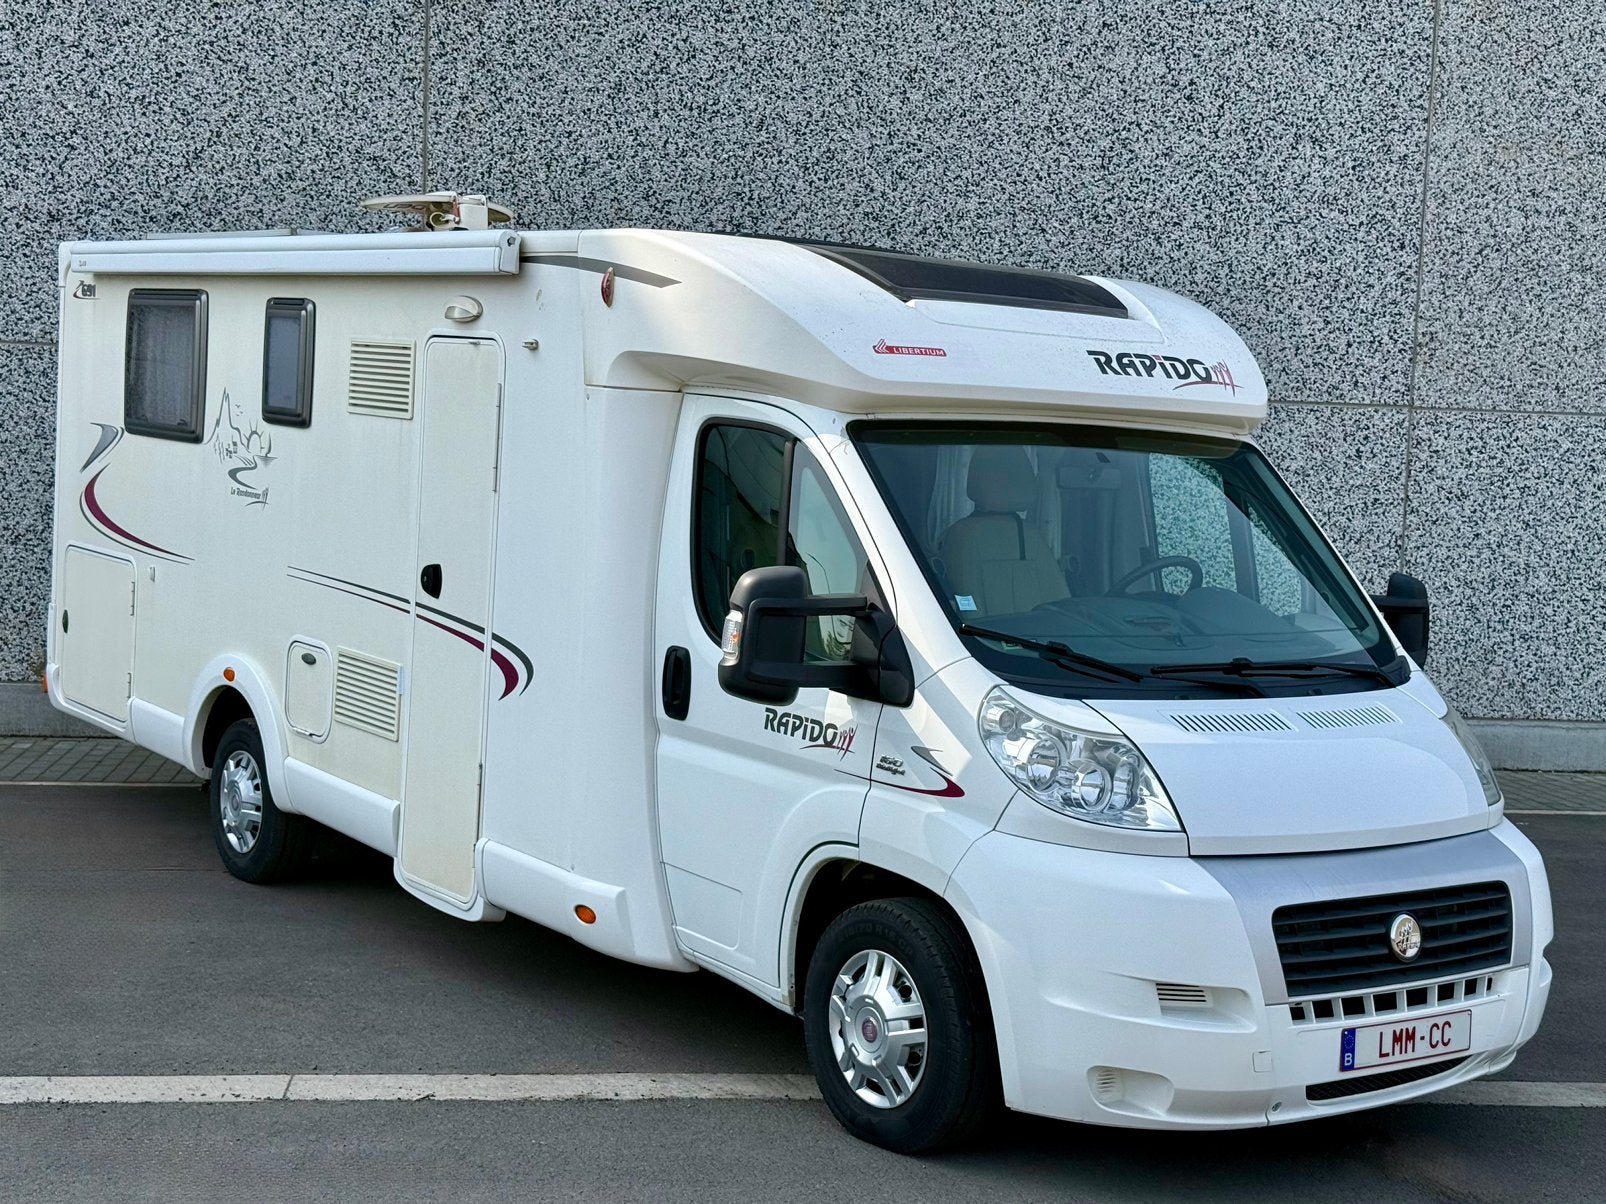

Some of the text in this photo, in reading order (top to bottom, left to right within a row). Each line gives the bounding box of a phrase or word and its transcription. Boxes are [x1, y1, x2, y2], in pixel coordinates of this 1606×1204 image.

[892, 346, 945, 356] LIBERTIUM
[1378, 1020, 1452, 1059] LMM-CC
[1344, 1052, 1353, 1067] B
